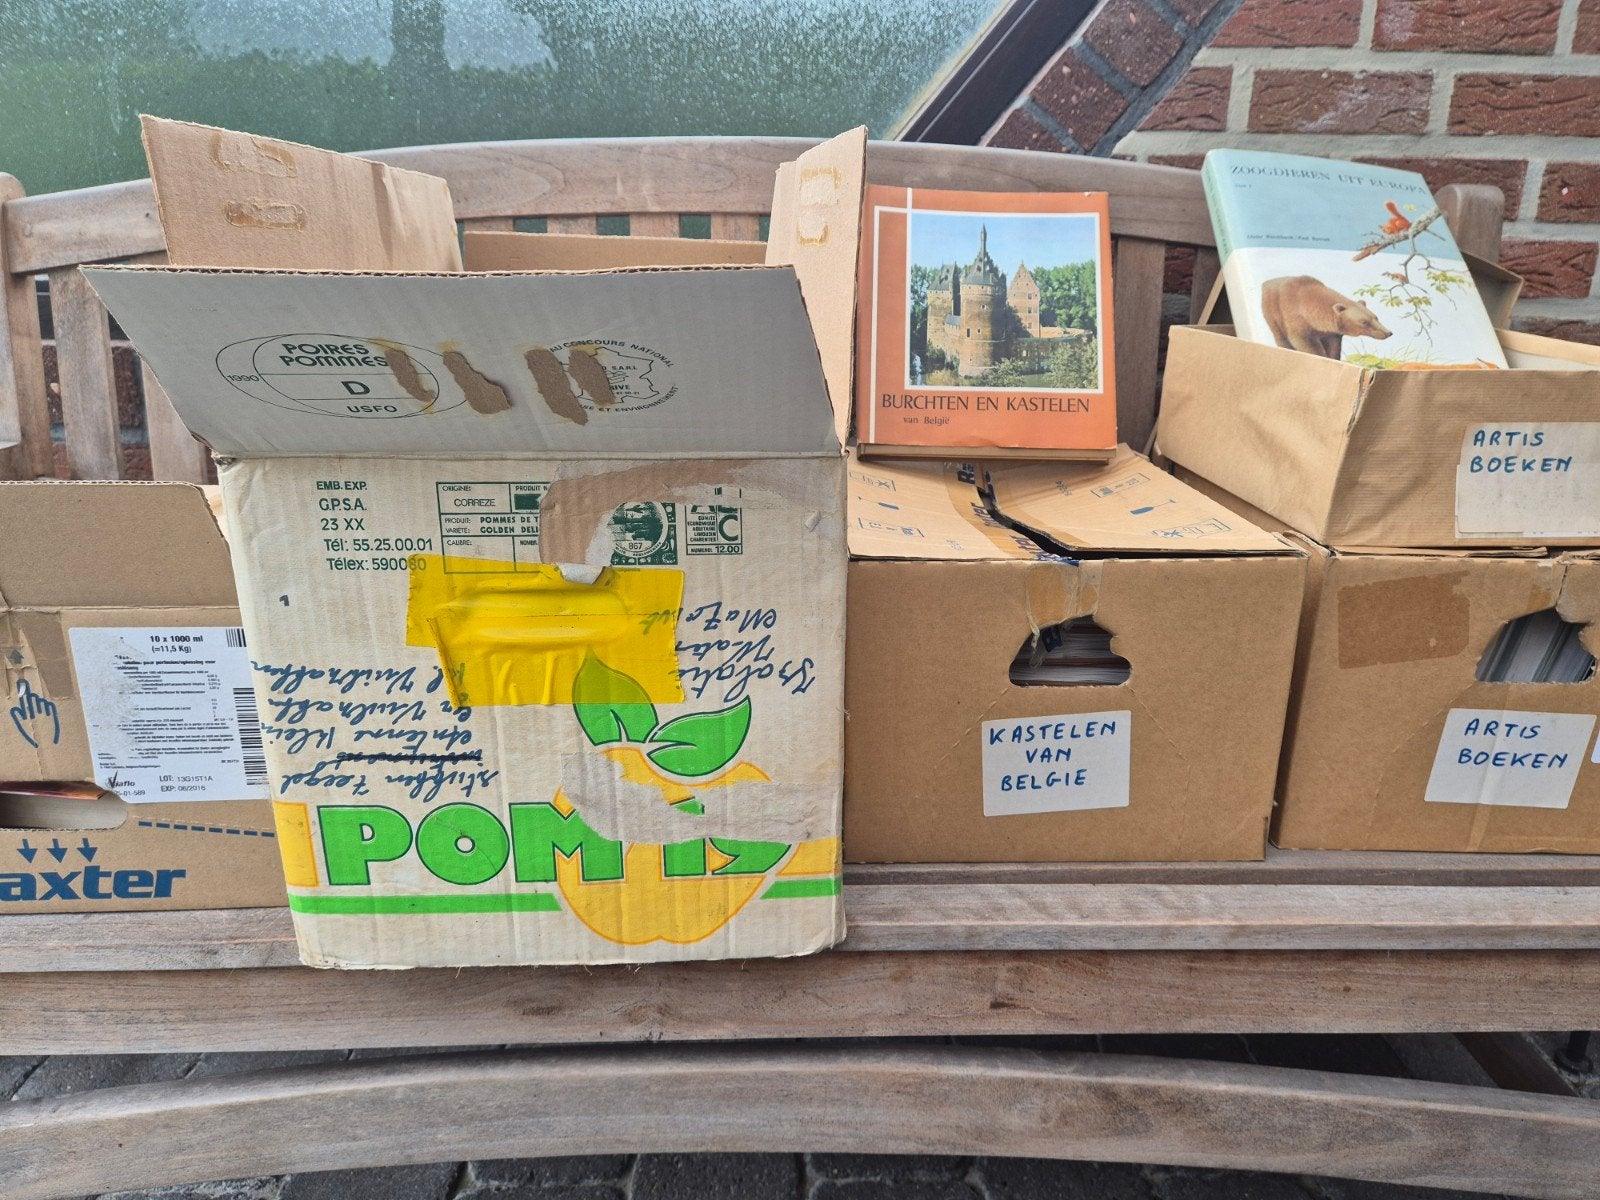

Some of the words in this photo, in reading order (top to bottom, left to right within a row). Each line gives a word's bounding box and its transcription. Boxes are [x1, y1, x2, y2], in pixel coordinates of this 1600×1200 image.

[1231, 165, 1331, 181] ZOOGDIEREN
[1370, 178, 1427, 195] EUROPA
[282, 343, 369, 355] POIRES
[563, 339, 625, 347] CONCOURS
[630, 343, 674, 368] NATIONAL
[279, 355, 389, 367] POMMES
[227, 374, 260, 382] 1990
[341, 380, 371, 395] D
[347, 405, 398, 413] USFO
[882, 393, 969, 410] BURCHTEN
[976, 396, 999, 411] EN
[1006, 396, 1090, 413] KASTELEN
[903, 417, 919, 425] van
[1473, 429, 1545, 448] ARTIS
[1470, 455, 1573, 473] BOEKEN
[454, 498, 496, 507] CORREZE
[321, 518, 339, 531] 23
[343, 518, 366, 531] XX
[480, 516, 516, 524] POMMES
[480, 526, 515, 534] GOLDEN
[324, 538, 349, 551] Tél:
[353, 538, 433, 551] 55.25.00.01
[327, 557, 369, 571] Télex:
[150, 635, 161, 643] 10
[171, 635, 191, 643] 1000
[193, 635, 204, 643] ml
[989, 721, 1116, 746] KASTELEN
[1464, 718, 1541, 739] ARTIS
[1025, 747, 1072, 764] VAN
[1457, 747, 1569, 769] BOEKEN
[1001, 768, 1088, 792] BELGIE
